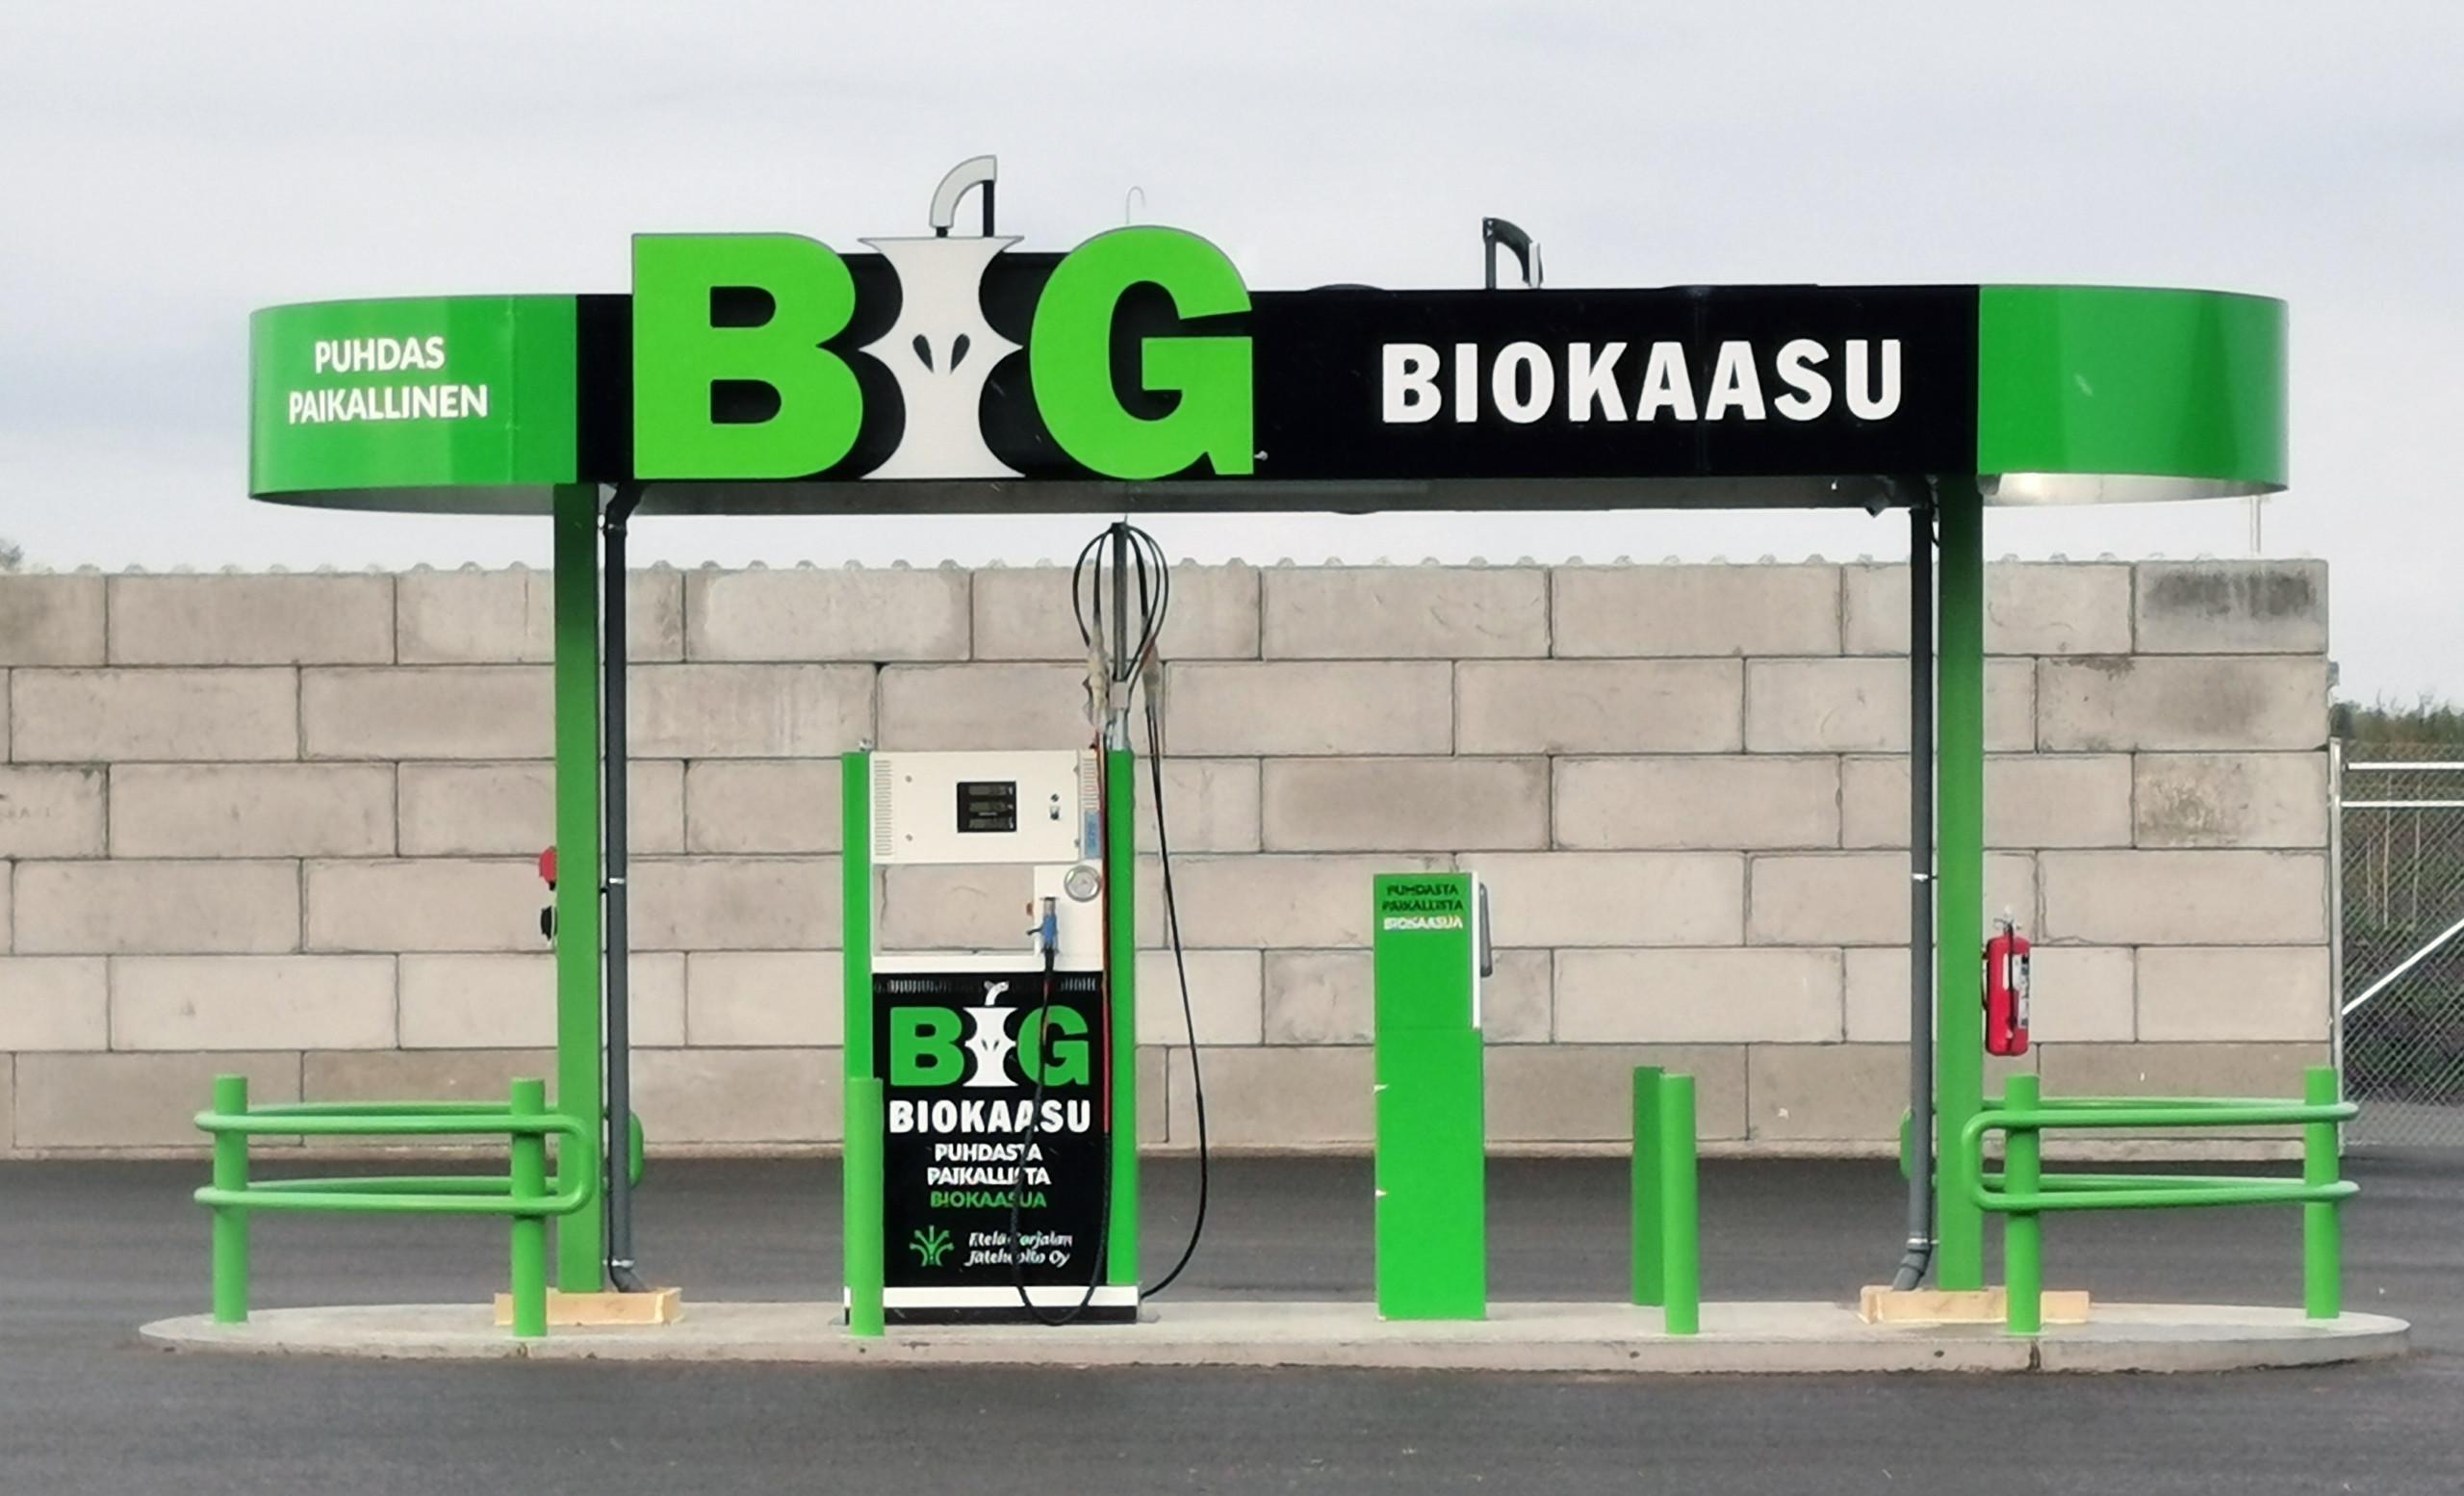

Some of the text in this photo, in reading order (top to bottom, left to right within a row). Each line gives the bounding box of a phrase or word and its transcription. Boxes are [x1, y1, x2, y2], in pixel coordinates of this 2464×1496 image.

[314, 336, 447, 374] PUHDAS
[1381, 338, 1903, 425] BIOKAASU
[289, 384, 489, 426] PAIKALLINEN
[888, 1099, 1091, 1134] BIOKAASU
[1048, 1250, 1071, 1268] Oy
